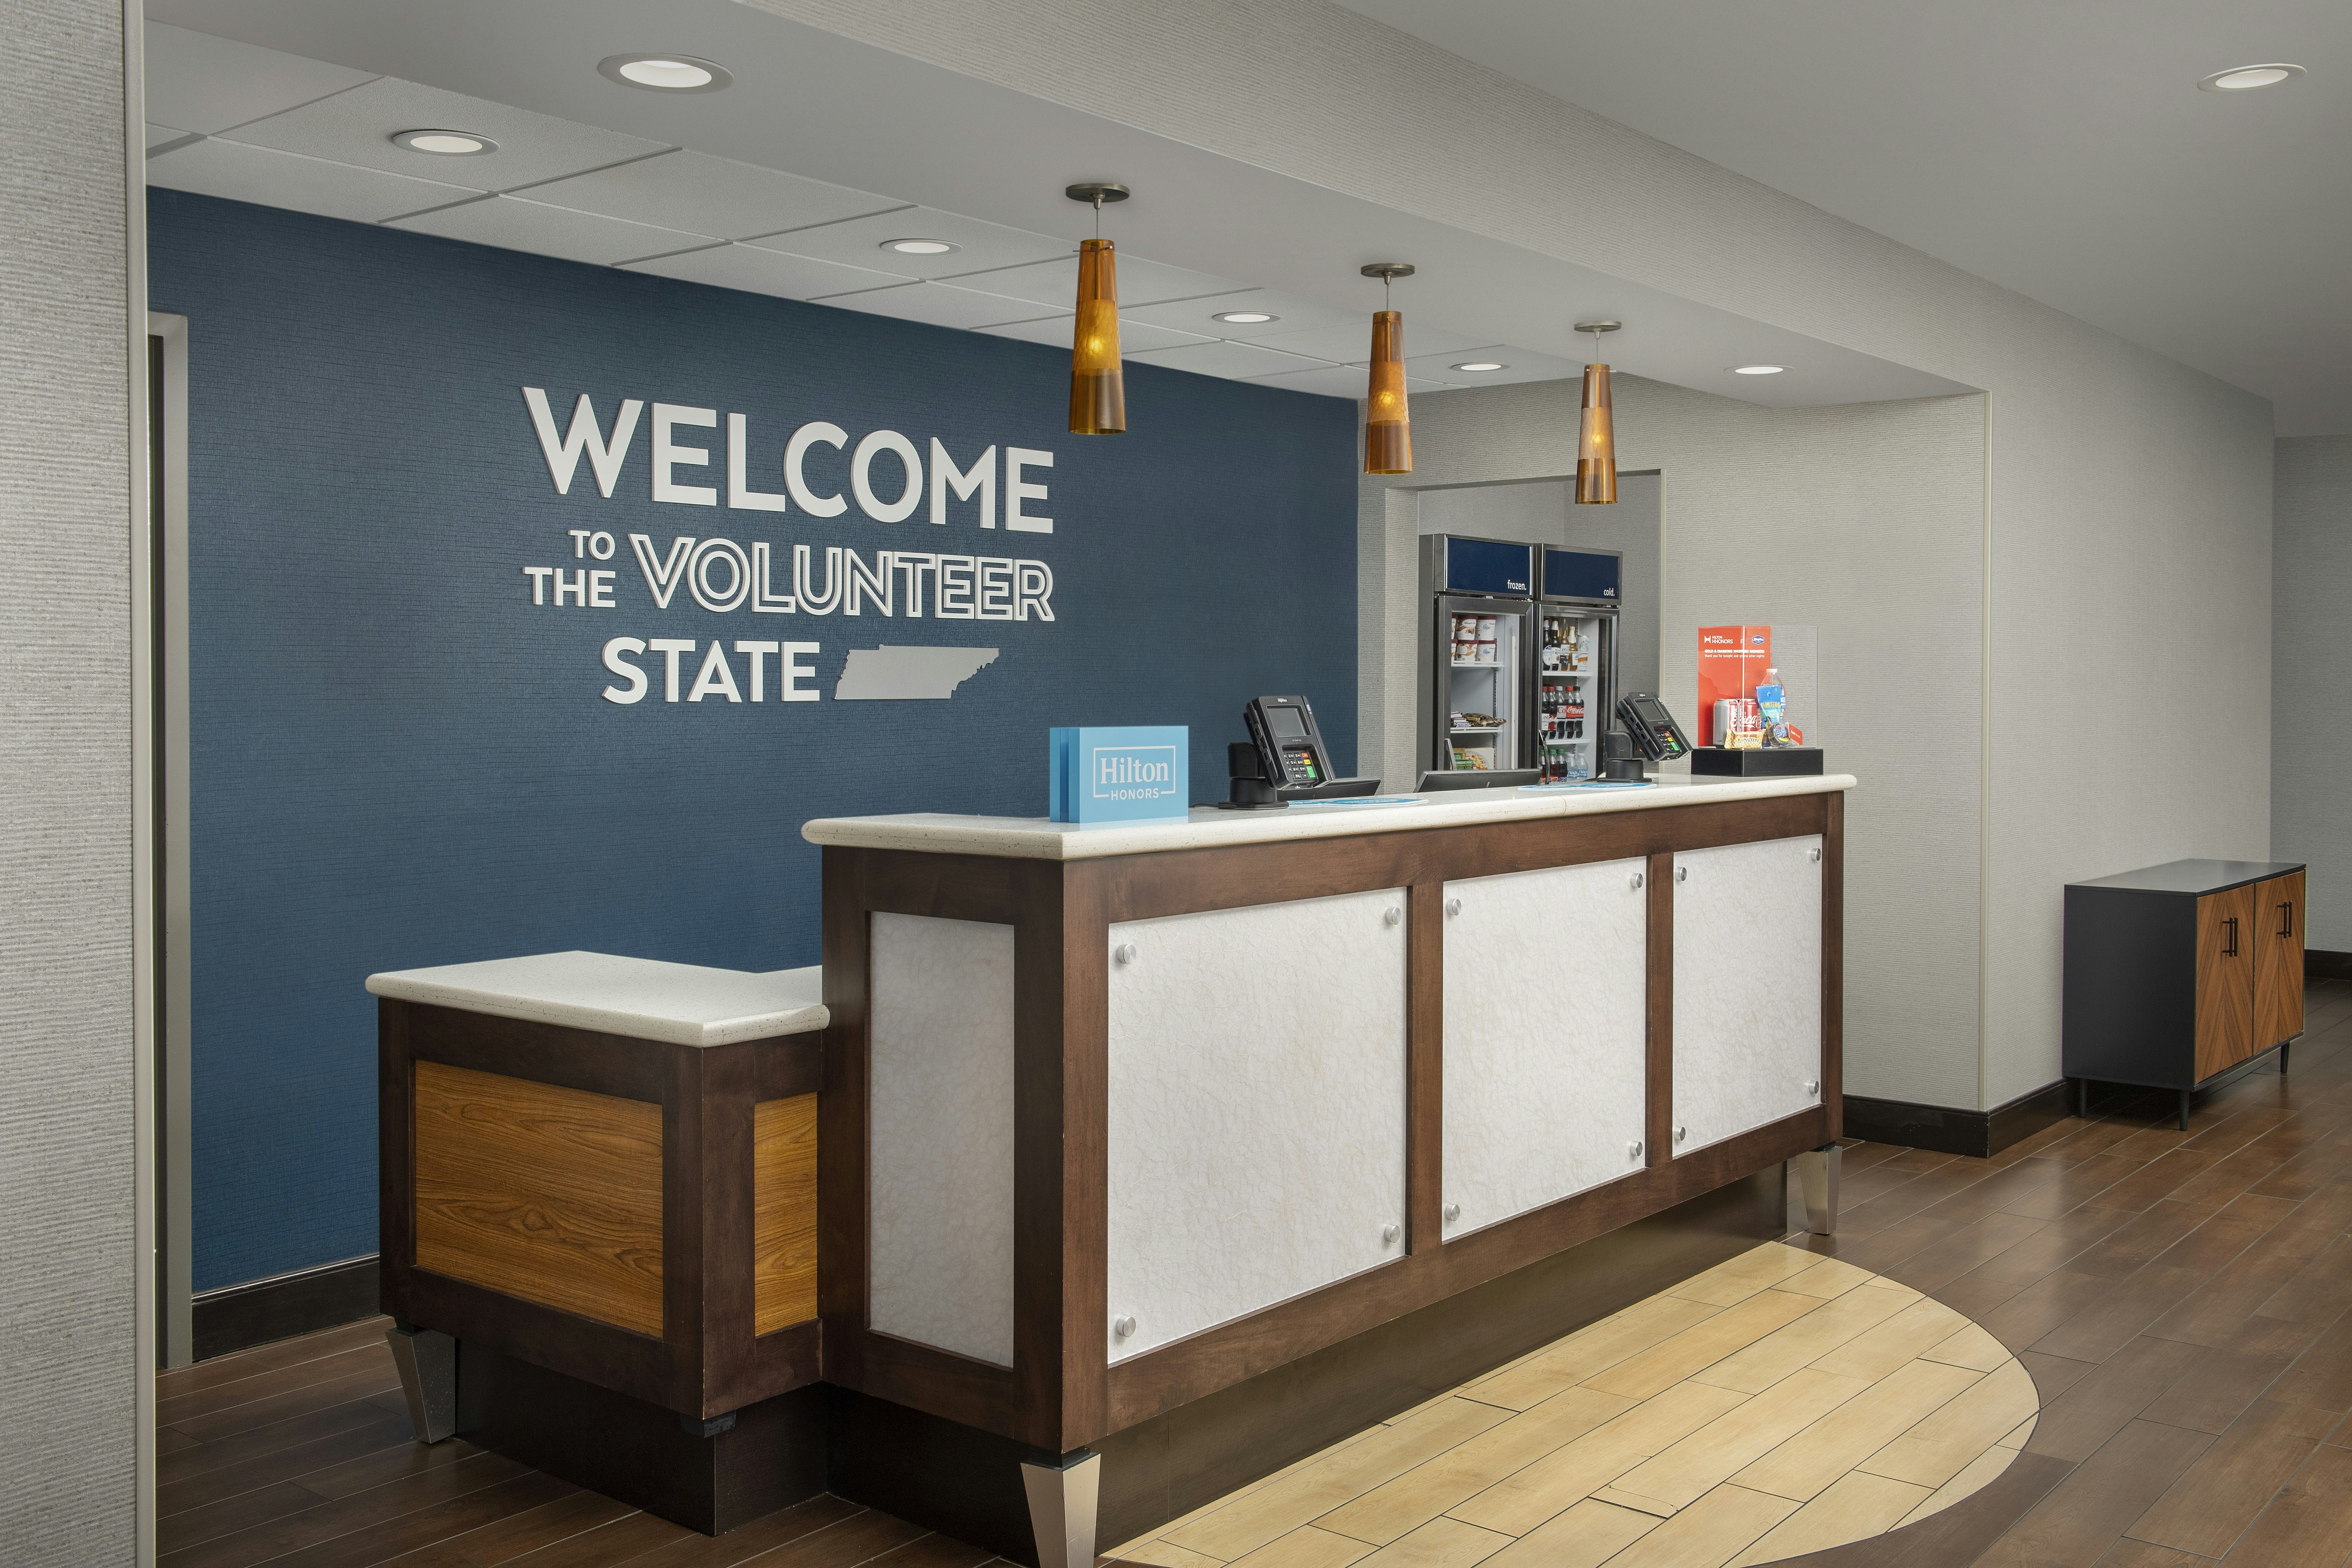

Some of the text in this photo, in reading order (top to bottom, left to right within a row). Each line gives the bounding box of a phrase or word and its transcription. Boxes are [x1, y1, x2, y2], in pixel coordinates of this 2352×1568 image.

[521, 387, 1054, 534] WELCOME
[568, 530, 615, 560] TO
[523, 534, 1055, 622] THE VOLUNTEER
[1507, 580, 1527, 591] frozen.
[1603, 588, 1615, 597] cold.
[601, 637, 821, 704] STATE
[1100, 757, 1169, 784] Hilton
[1111, 788, 1160, 801] HONORS
